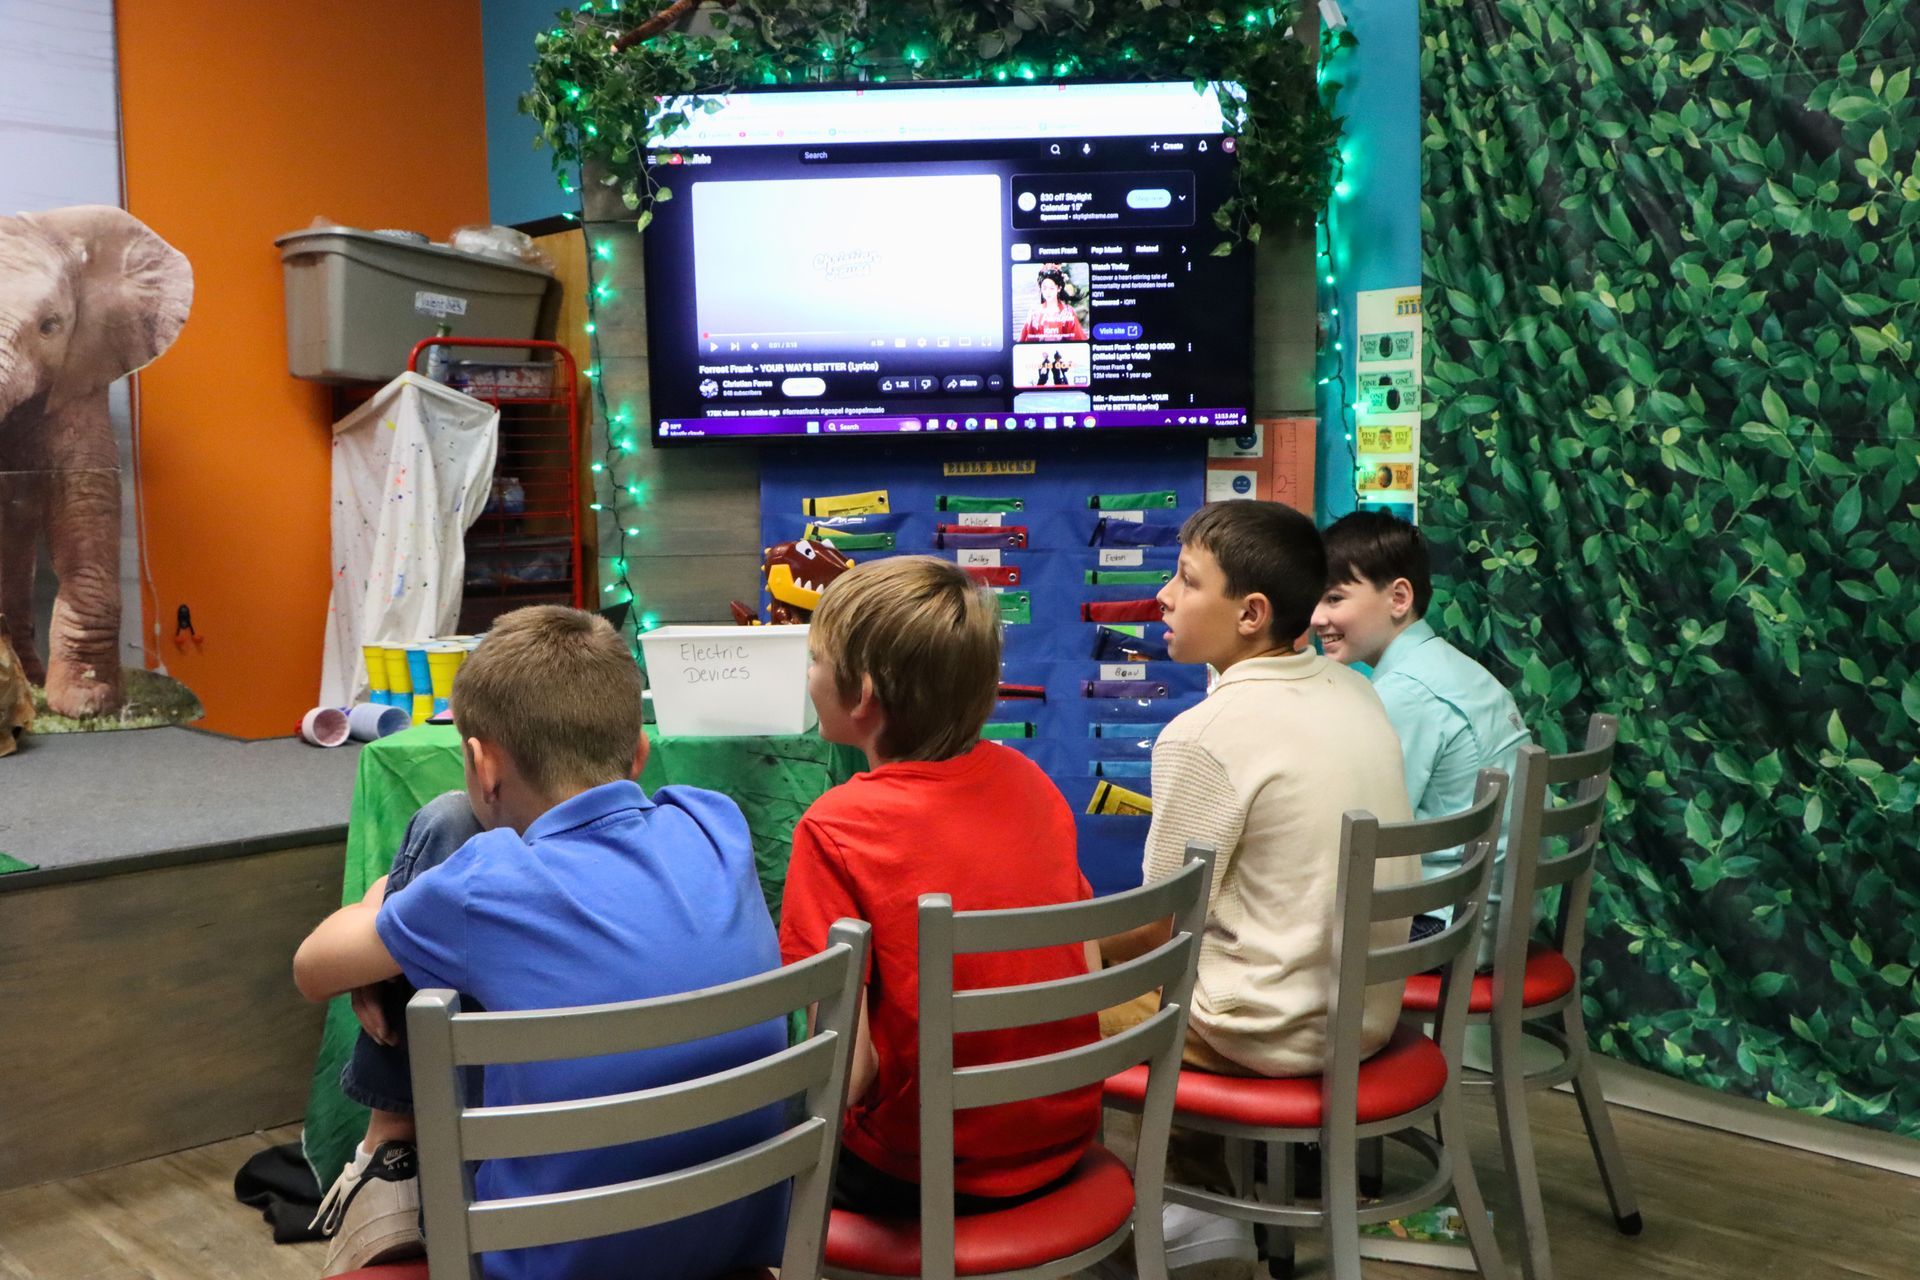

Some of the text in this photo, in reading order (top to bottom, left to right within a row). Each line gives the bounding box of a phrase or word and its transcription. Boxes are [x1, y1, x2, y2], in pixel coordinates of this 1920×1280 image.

[804, 151, 828, 160] Search
[1040, 192, 1092, 202] $30 off Skylight
[1040, 203, 1070, 212] Calendar
[1091, 246, 1103, 255] Pop
[1111, 263, 1129, 271] Today
[1099, 327, 1125, 335] Visit site
[1114, 343, 1131, 351] Frank
[1116, 352, 1131, 361] Lyric
[1131, 352, 1151, 361] Video)
[699, 366, 729, 374] Forrest
[730, 365, 754, 374] Frank
[760, 364, 784, 373] YOUR
[785, 363, 812, 372] WAY'S
[813, 362, 847, 372] BETTER
[848, 361, 879, 373] (Lyrics)
[722, 380, 752, 388] Christian
[959, 379, 978, 387] Share
[1151, 393, 1169, 401] YOUR
[1137, 403, 1159, 411] (Lyrics)
[769, 409, 780, 417] ago
[947, 460, 1033, 473] BIBLE BUCKS
[1276, 474, 1288, 493] 2
[680, 643, 749, 662] Electric
[683, 666, 750, 683] Devices
[386, 1148, 405, 1159] NIKE
